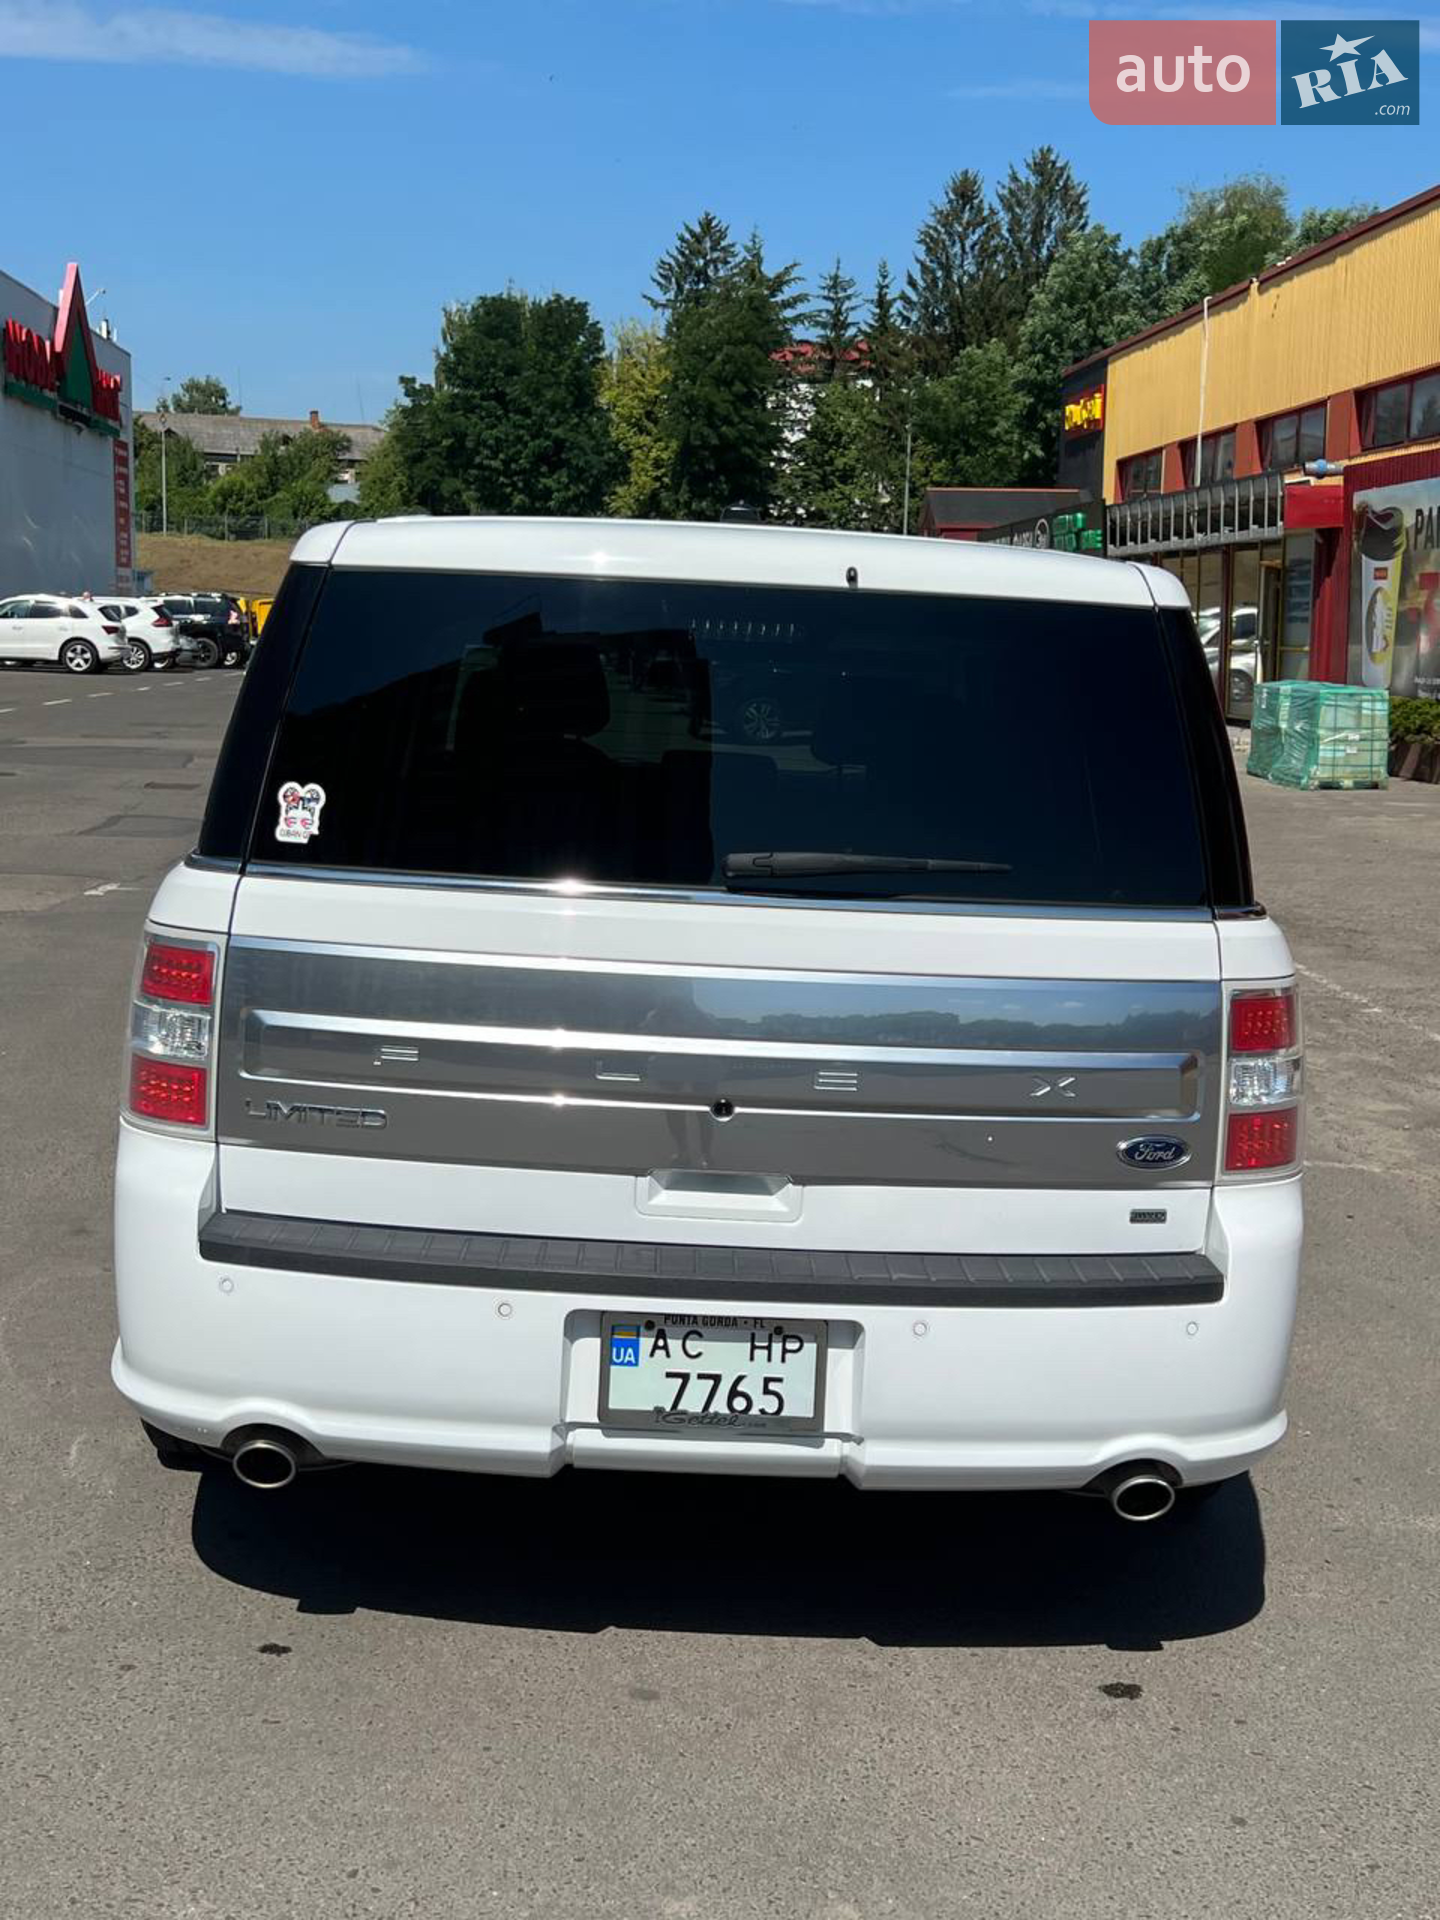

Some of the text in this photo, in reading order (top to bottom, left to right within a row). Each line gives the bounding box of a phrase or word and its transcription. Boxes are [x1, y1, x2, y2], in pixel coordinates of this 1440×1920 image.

[245, 1098, 388, 1129] LIMITED
[1134, 1143, 1176, 1161] Ford
[664, 1314, 766, 1329] PUNTA GORDA FL
[612, 1347, 636, 1364] UA
[649, 1328, 804, 1364] AC HP
[665, 1371, 784, 1416] 7765
